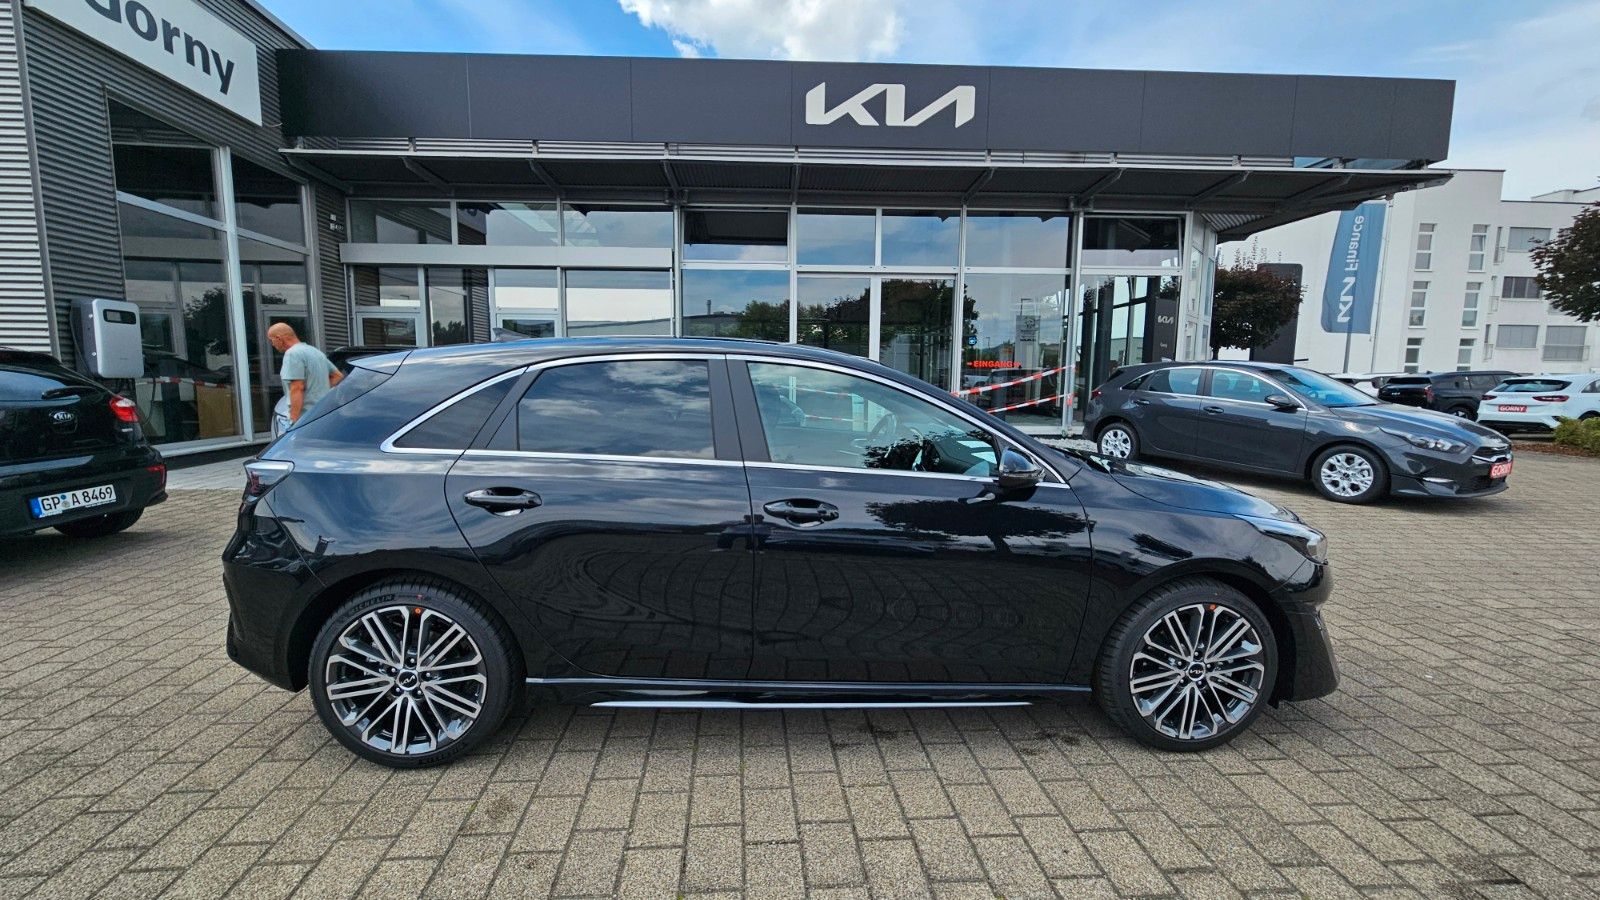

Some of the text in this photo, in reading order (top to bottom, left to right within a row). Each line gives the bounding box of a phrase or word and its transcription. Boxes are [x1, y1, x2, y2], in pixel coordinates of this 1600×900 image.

[805, 82, 976, 128] KIA
[973, 360, 1013, 368] EINGANG
[55, 411, 74, 421] KIA
[41, 496, 61, 511] GP
[71, 493, 81, 506] A
[82, 486, 113, 503] 8469
